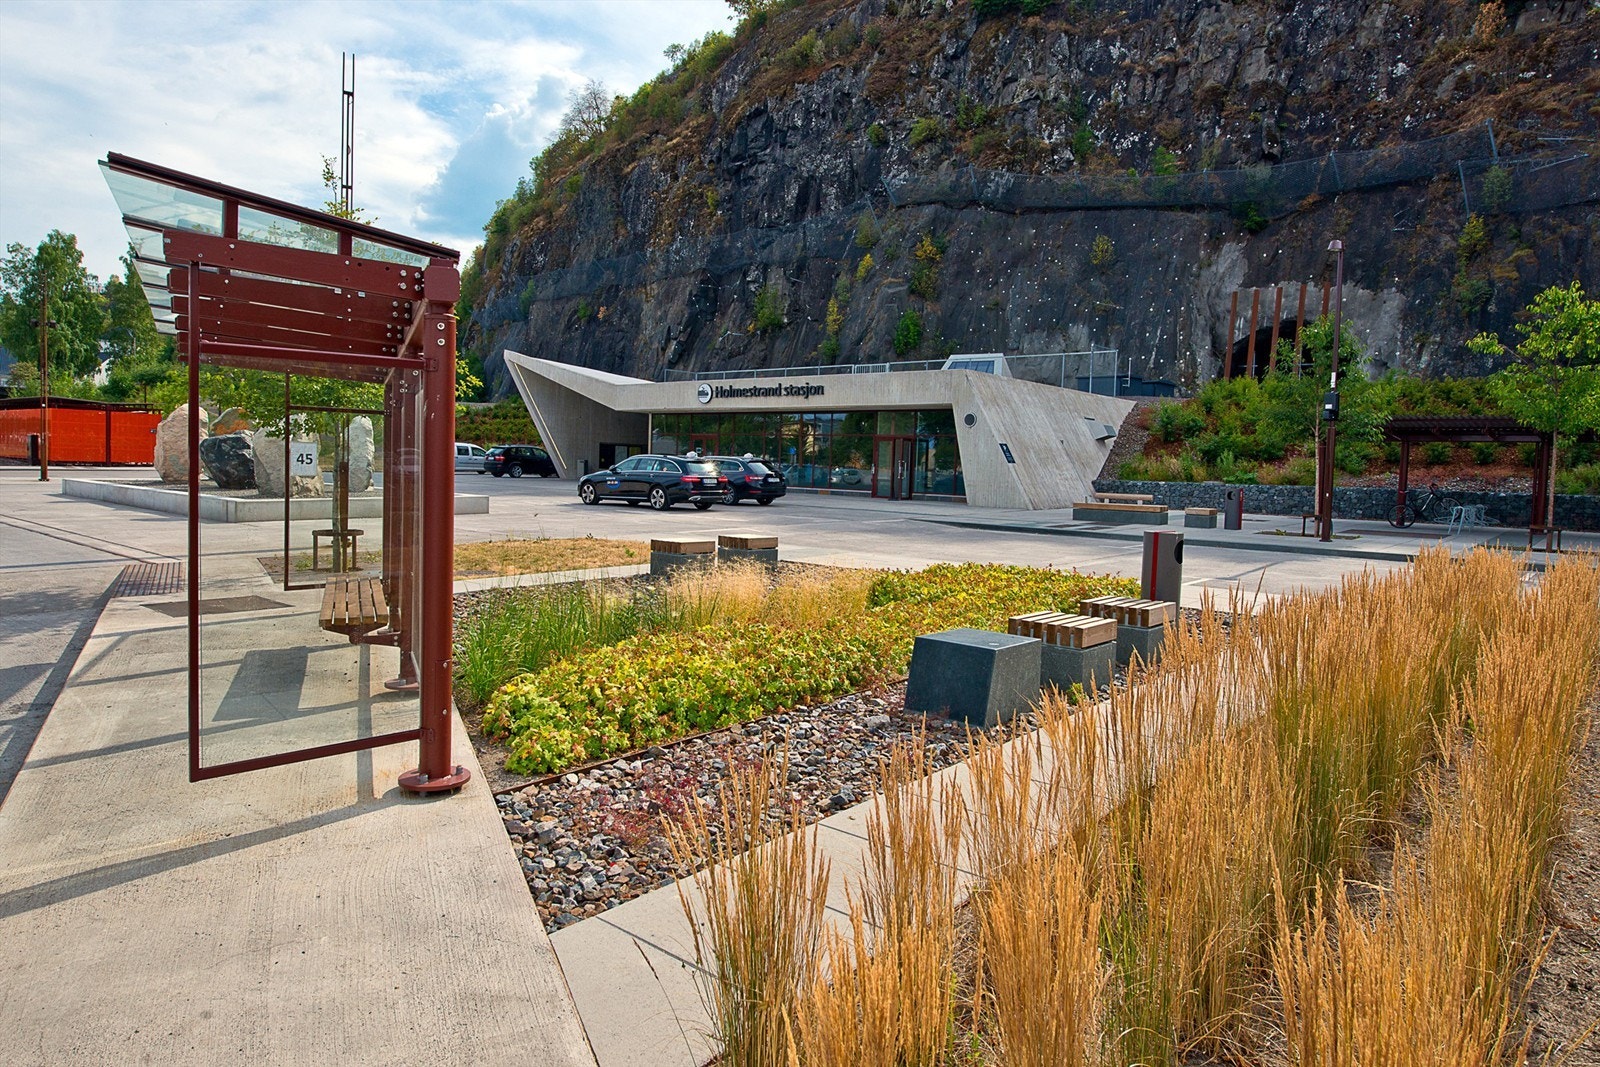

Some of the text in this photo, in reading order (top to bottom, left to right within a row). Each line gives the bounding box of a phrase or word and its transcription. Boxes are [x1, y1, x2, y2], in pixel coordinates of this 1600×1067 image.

[715, 382, 824, 399] Holmestrand stasjon
[296, 453, 313, 465] 45
